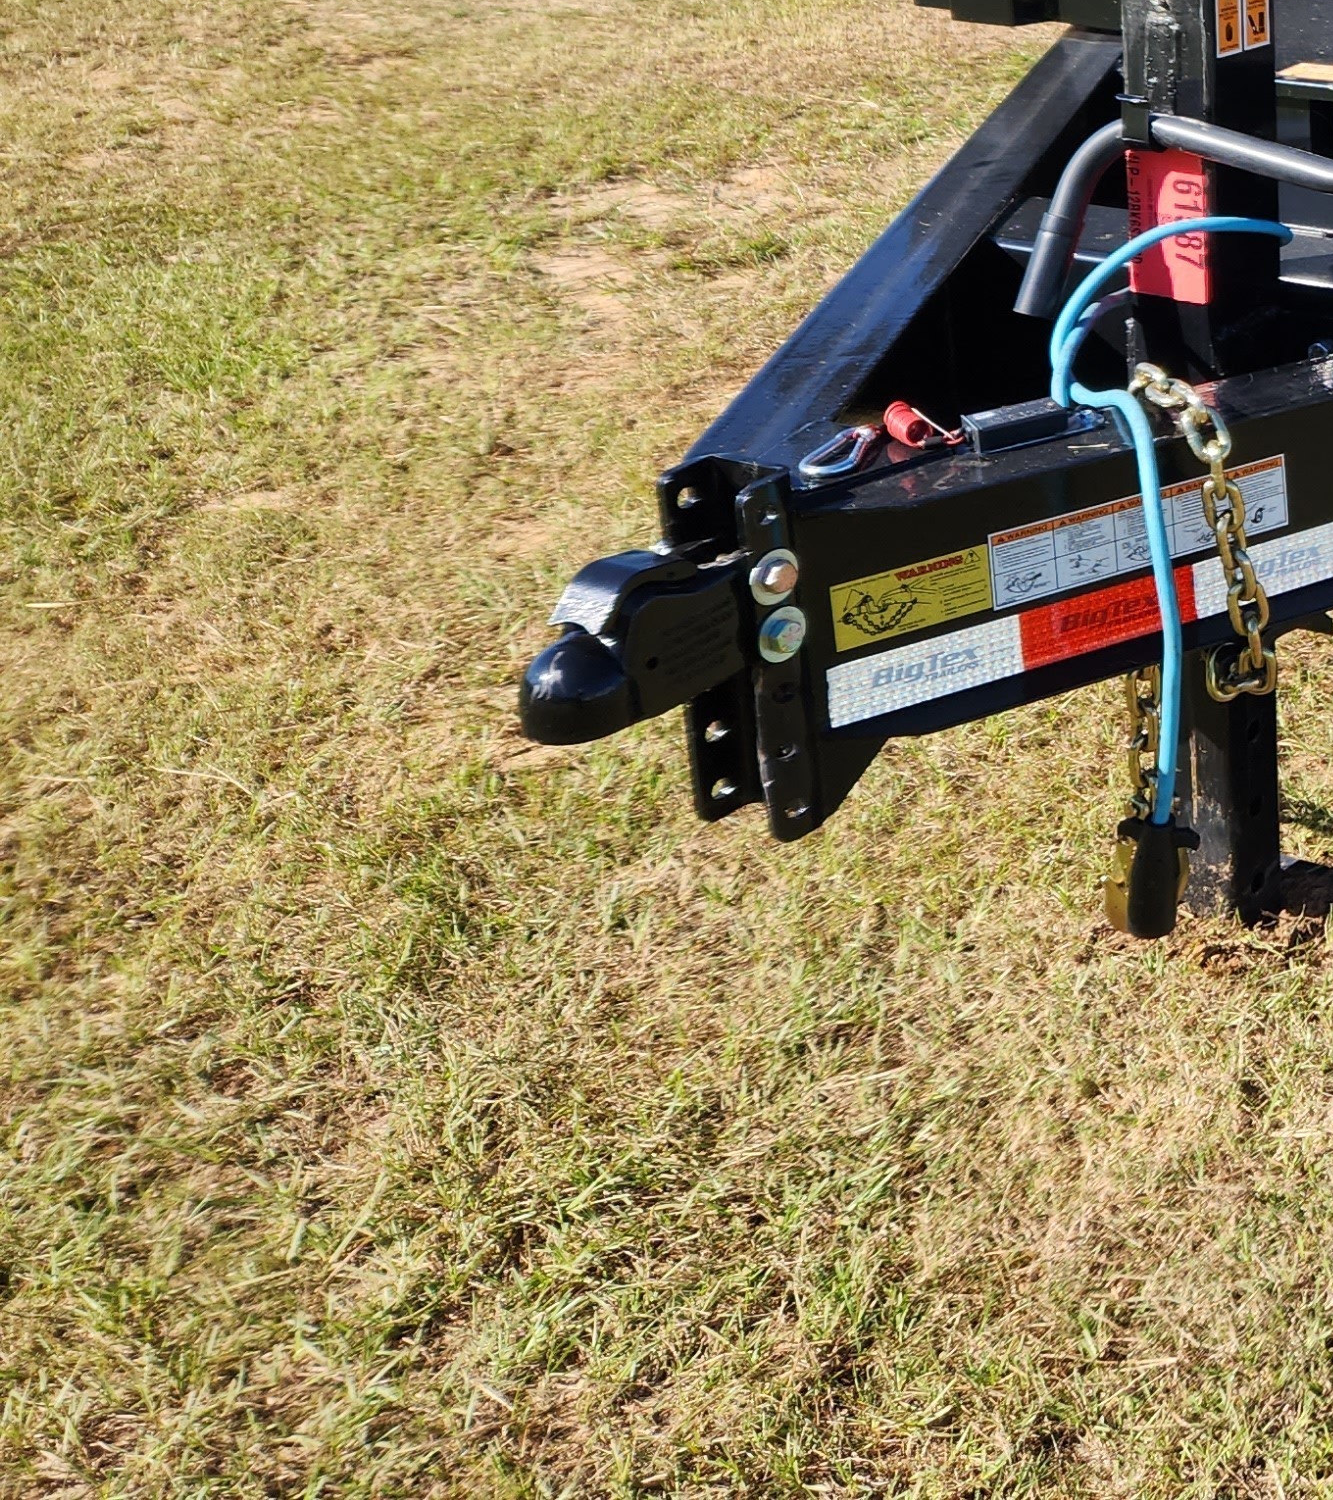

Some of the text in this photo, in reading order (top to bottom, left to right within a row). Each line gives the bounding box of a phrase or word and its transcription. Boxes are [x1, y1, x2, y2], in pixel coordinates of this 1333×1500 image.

[1068, 508, 1109, 523] WARNING
[1005, 525, 1048, 541] WARNING
[893, 554, 964, 581] WARNING
[1060, 594, 1160, 632] BigTex
[871, 645, 981, 688] BigTex
